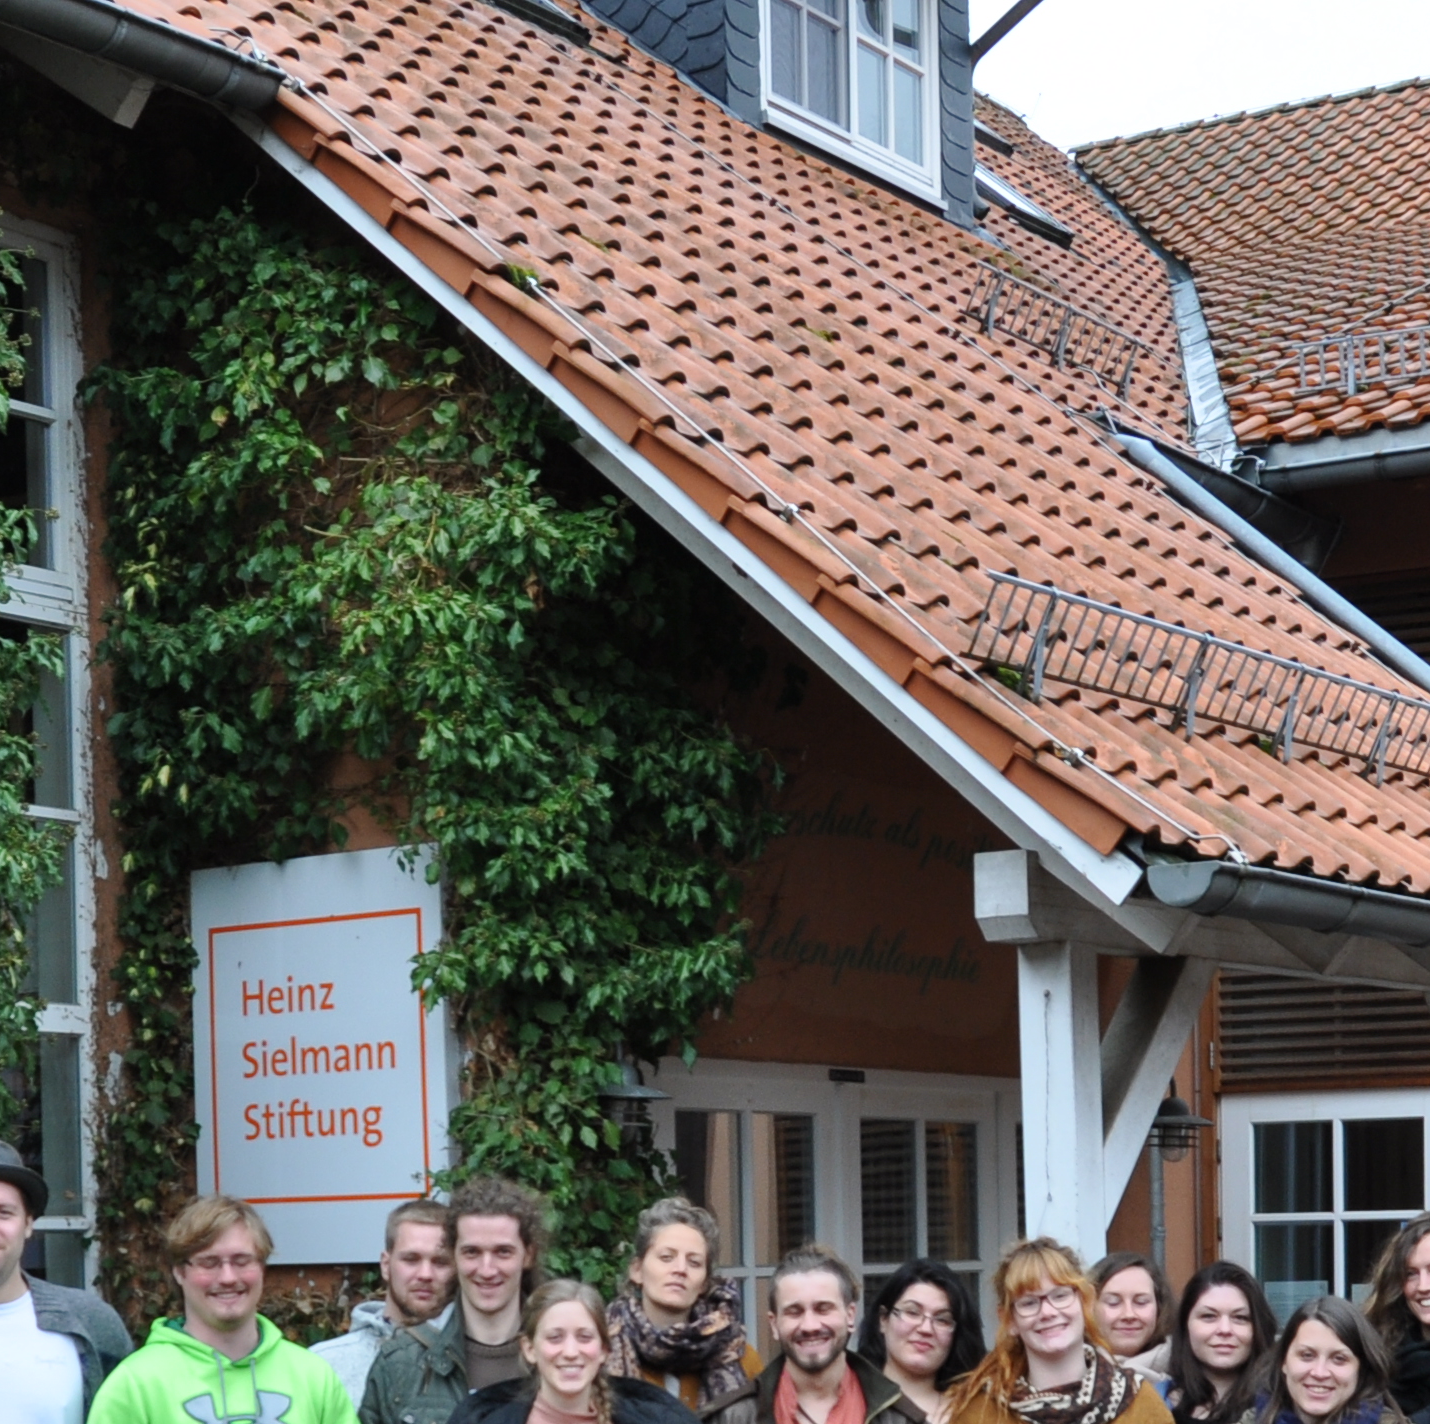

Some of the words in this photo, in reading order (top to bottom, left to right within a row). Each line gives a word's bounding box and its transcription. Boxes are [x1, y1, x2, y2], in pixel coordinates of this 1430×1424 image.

[751, 909, 981, 996] Lebensphilosophie
[241, 975, 335, 1016] Heinz
[243, 1036, 397, 1079] Sielmann
[244, 1099, 383, 1147] Stiftung
